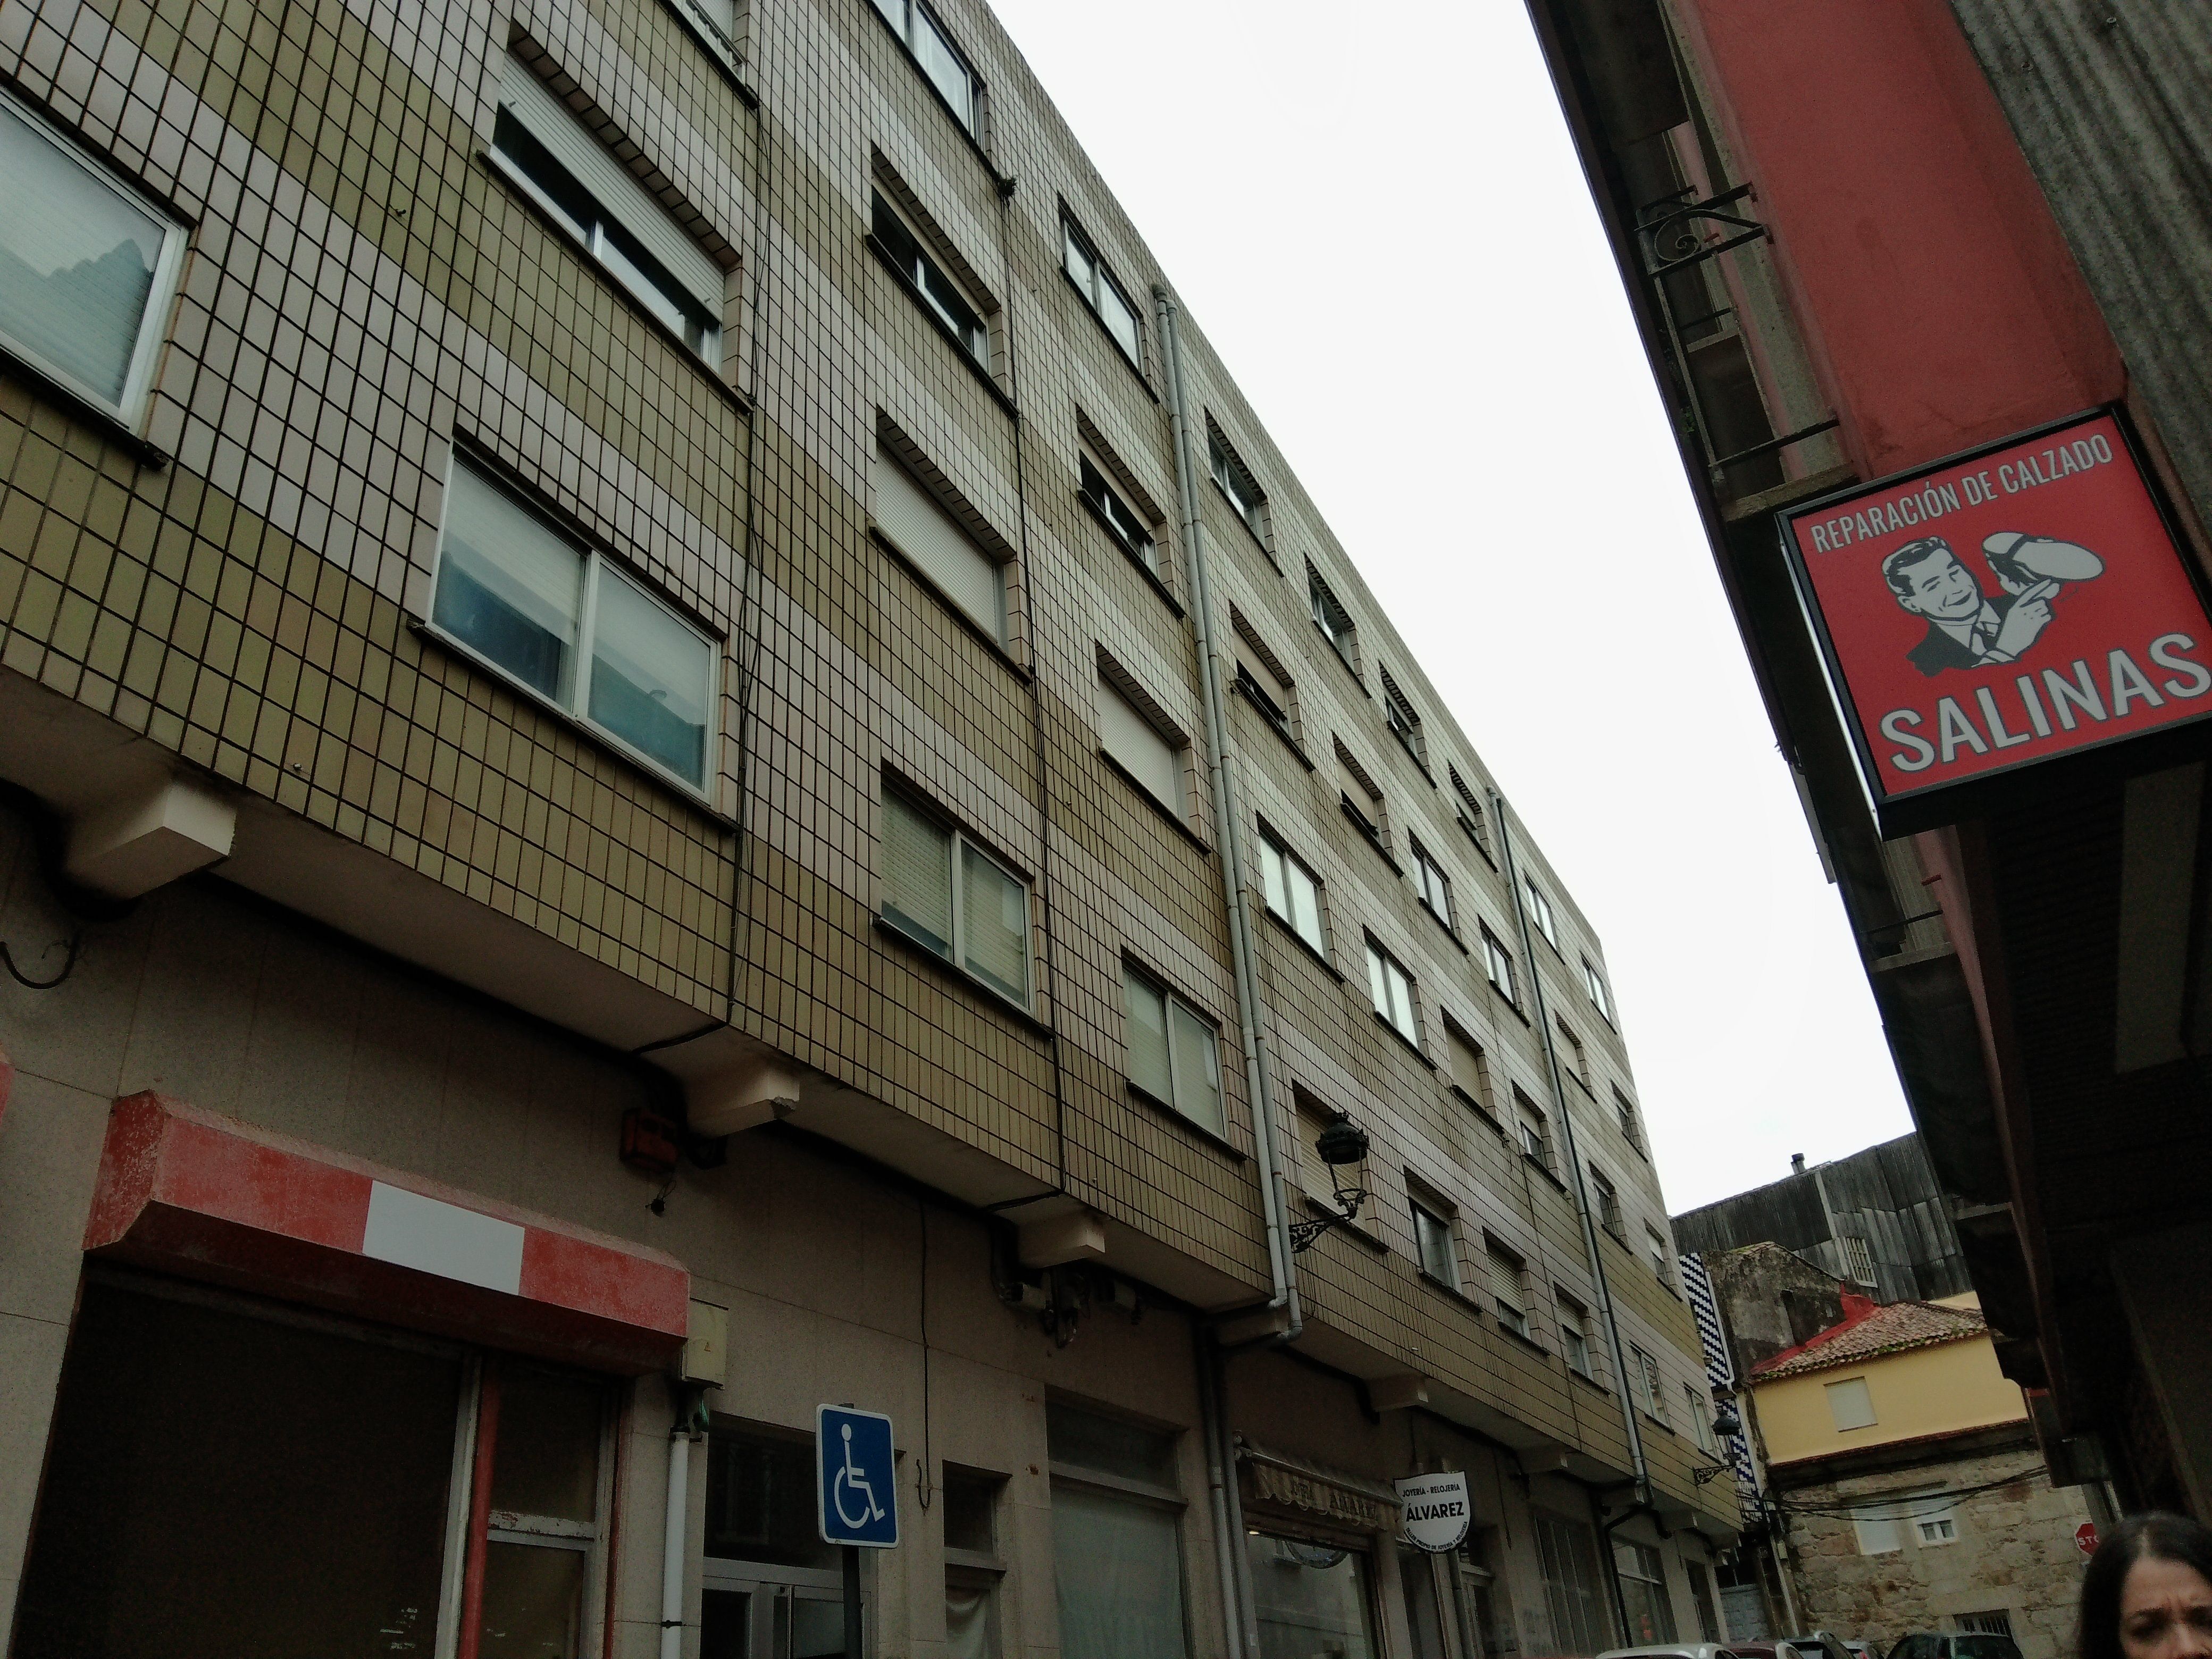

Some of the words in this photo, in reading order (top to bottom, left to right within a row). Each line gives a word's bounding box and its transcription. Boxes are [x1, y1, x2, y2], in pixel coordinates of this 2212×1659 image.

[1811, 481, 1960, 553] REPARACIÓN
[1962, 471, 1998, 507] DE
[1999, 434, 2113, 494] CALZADO
[1880, 633, 2211, 772] SALINAS
[1402, 1487, 1426, 1497] JOYERÍA
[1406, 1502, 1464, 1522] ÁLVAREZ
[1405, 1527, 1417, 1541] TALLER
[2078, 1535, 2099, 1546] STO
